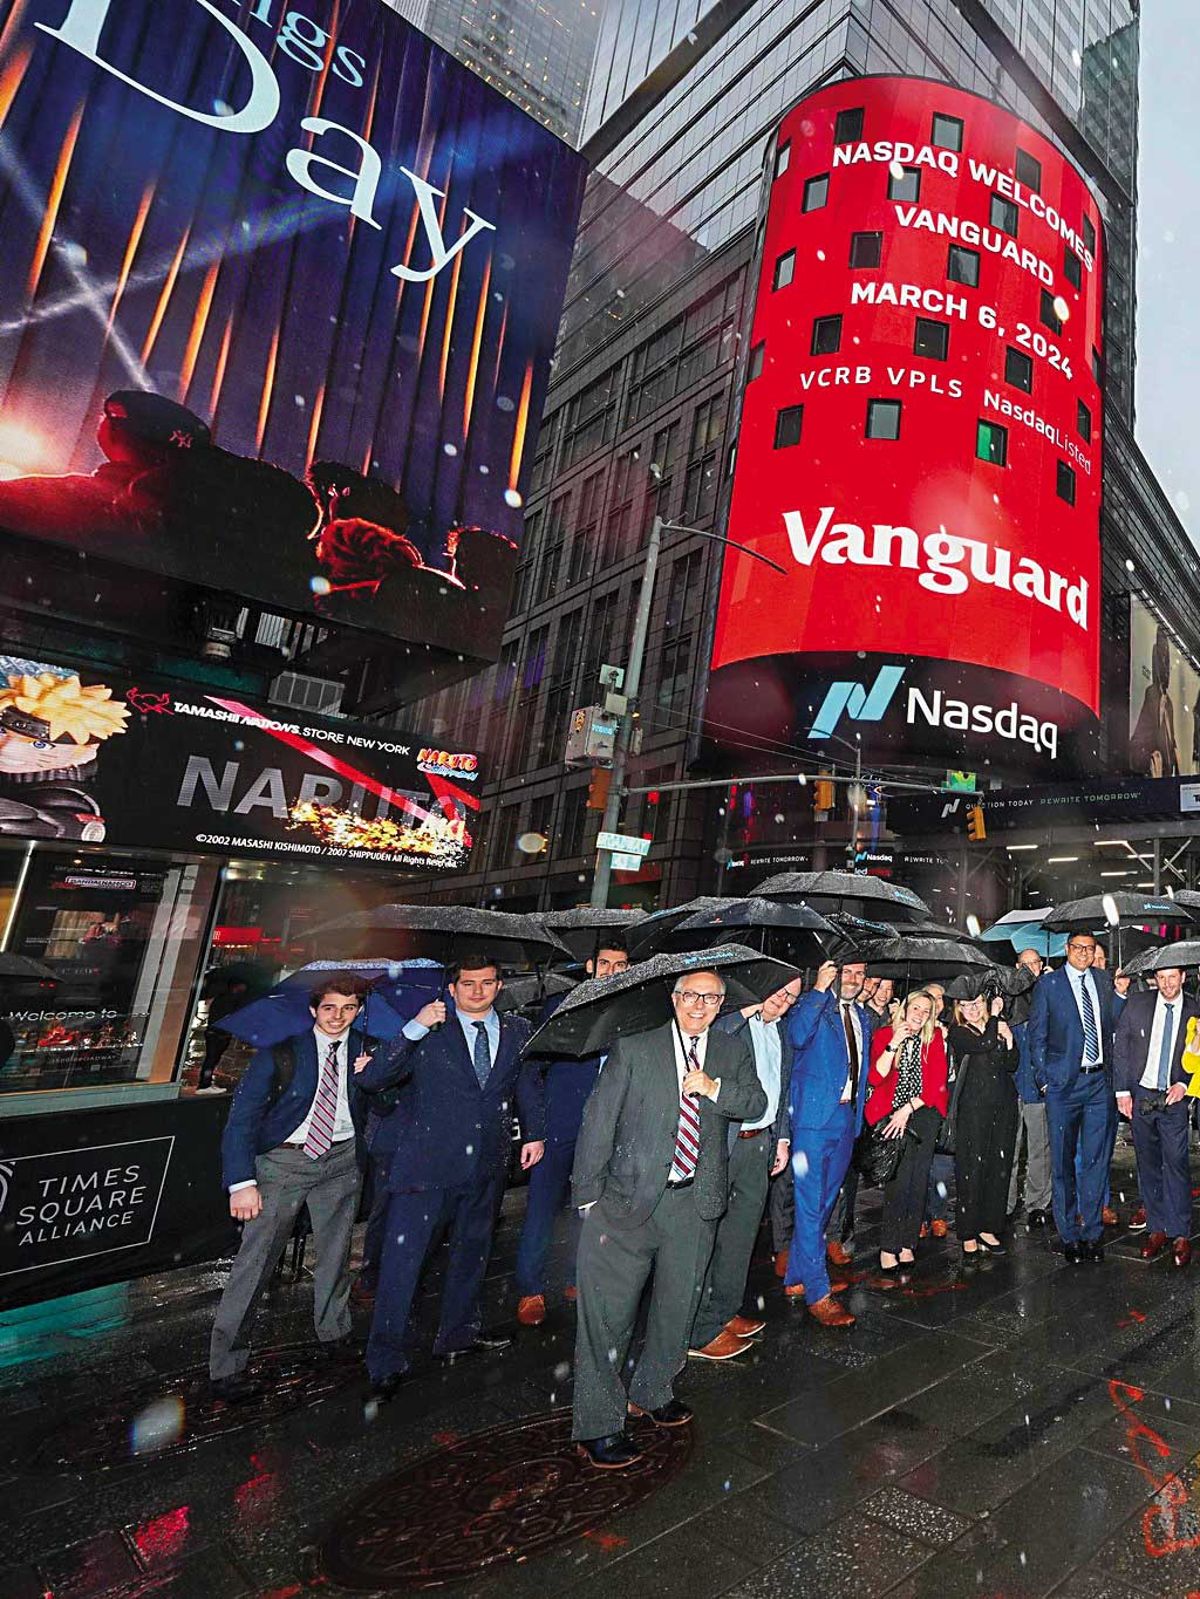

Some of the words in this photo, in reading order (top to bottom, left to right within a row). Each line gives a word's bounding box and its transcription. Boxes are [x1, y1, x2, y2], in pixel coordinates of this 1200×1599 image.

[832, 141, 959, 178] NASDAQ
[968, 159, 1093, 273] WELCOMES
[894, 205, 1054, 286] VANGUARD
[850, 282, 967, 321] MARCH
[978, 306, 1005, 337] 6,
[1015, 322, 1074, 381] 2024
[800, 366, 871, 390] VCRB
[886, 366, 963, 398] VPLS
[782, 507, 1089, 632] Vanguard
[173, 702, 239, 724] TAMASHII
[302, 727, 345, 744] STORE
[346, 735, 376, 750] NEW
[377, 741, 411, 756] YORK
[906, 687, 1058, 760] Nasdaq
[417, 748, 478, 771] NARUTO
[1008, 799, 1034, 807] TODAY
[1040, 796, 1080, 805] REWRITE
[195, 833, 230, 846] ©2002
[231, 837, 273, 850] MASASHI
[274, 842, 321, 855] KISHIMOTO
[328, 847, 347, 857] 2007
[348, 849, 391, 861] SHIPPUDEN
[402, 854, 425, 866] Rights
[866, 854, 893, 863] Nasdaq
[38, 1165, 140, 1197] TIMES
[16, 1186, 147, 1226] SQUARE
[18, 1211, 134, 1246] ALLIANCE
